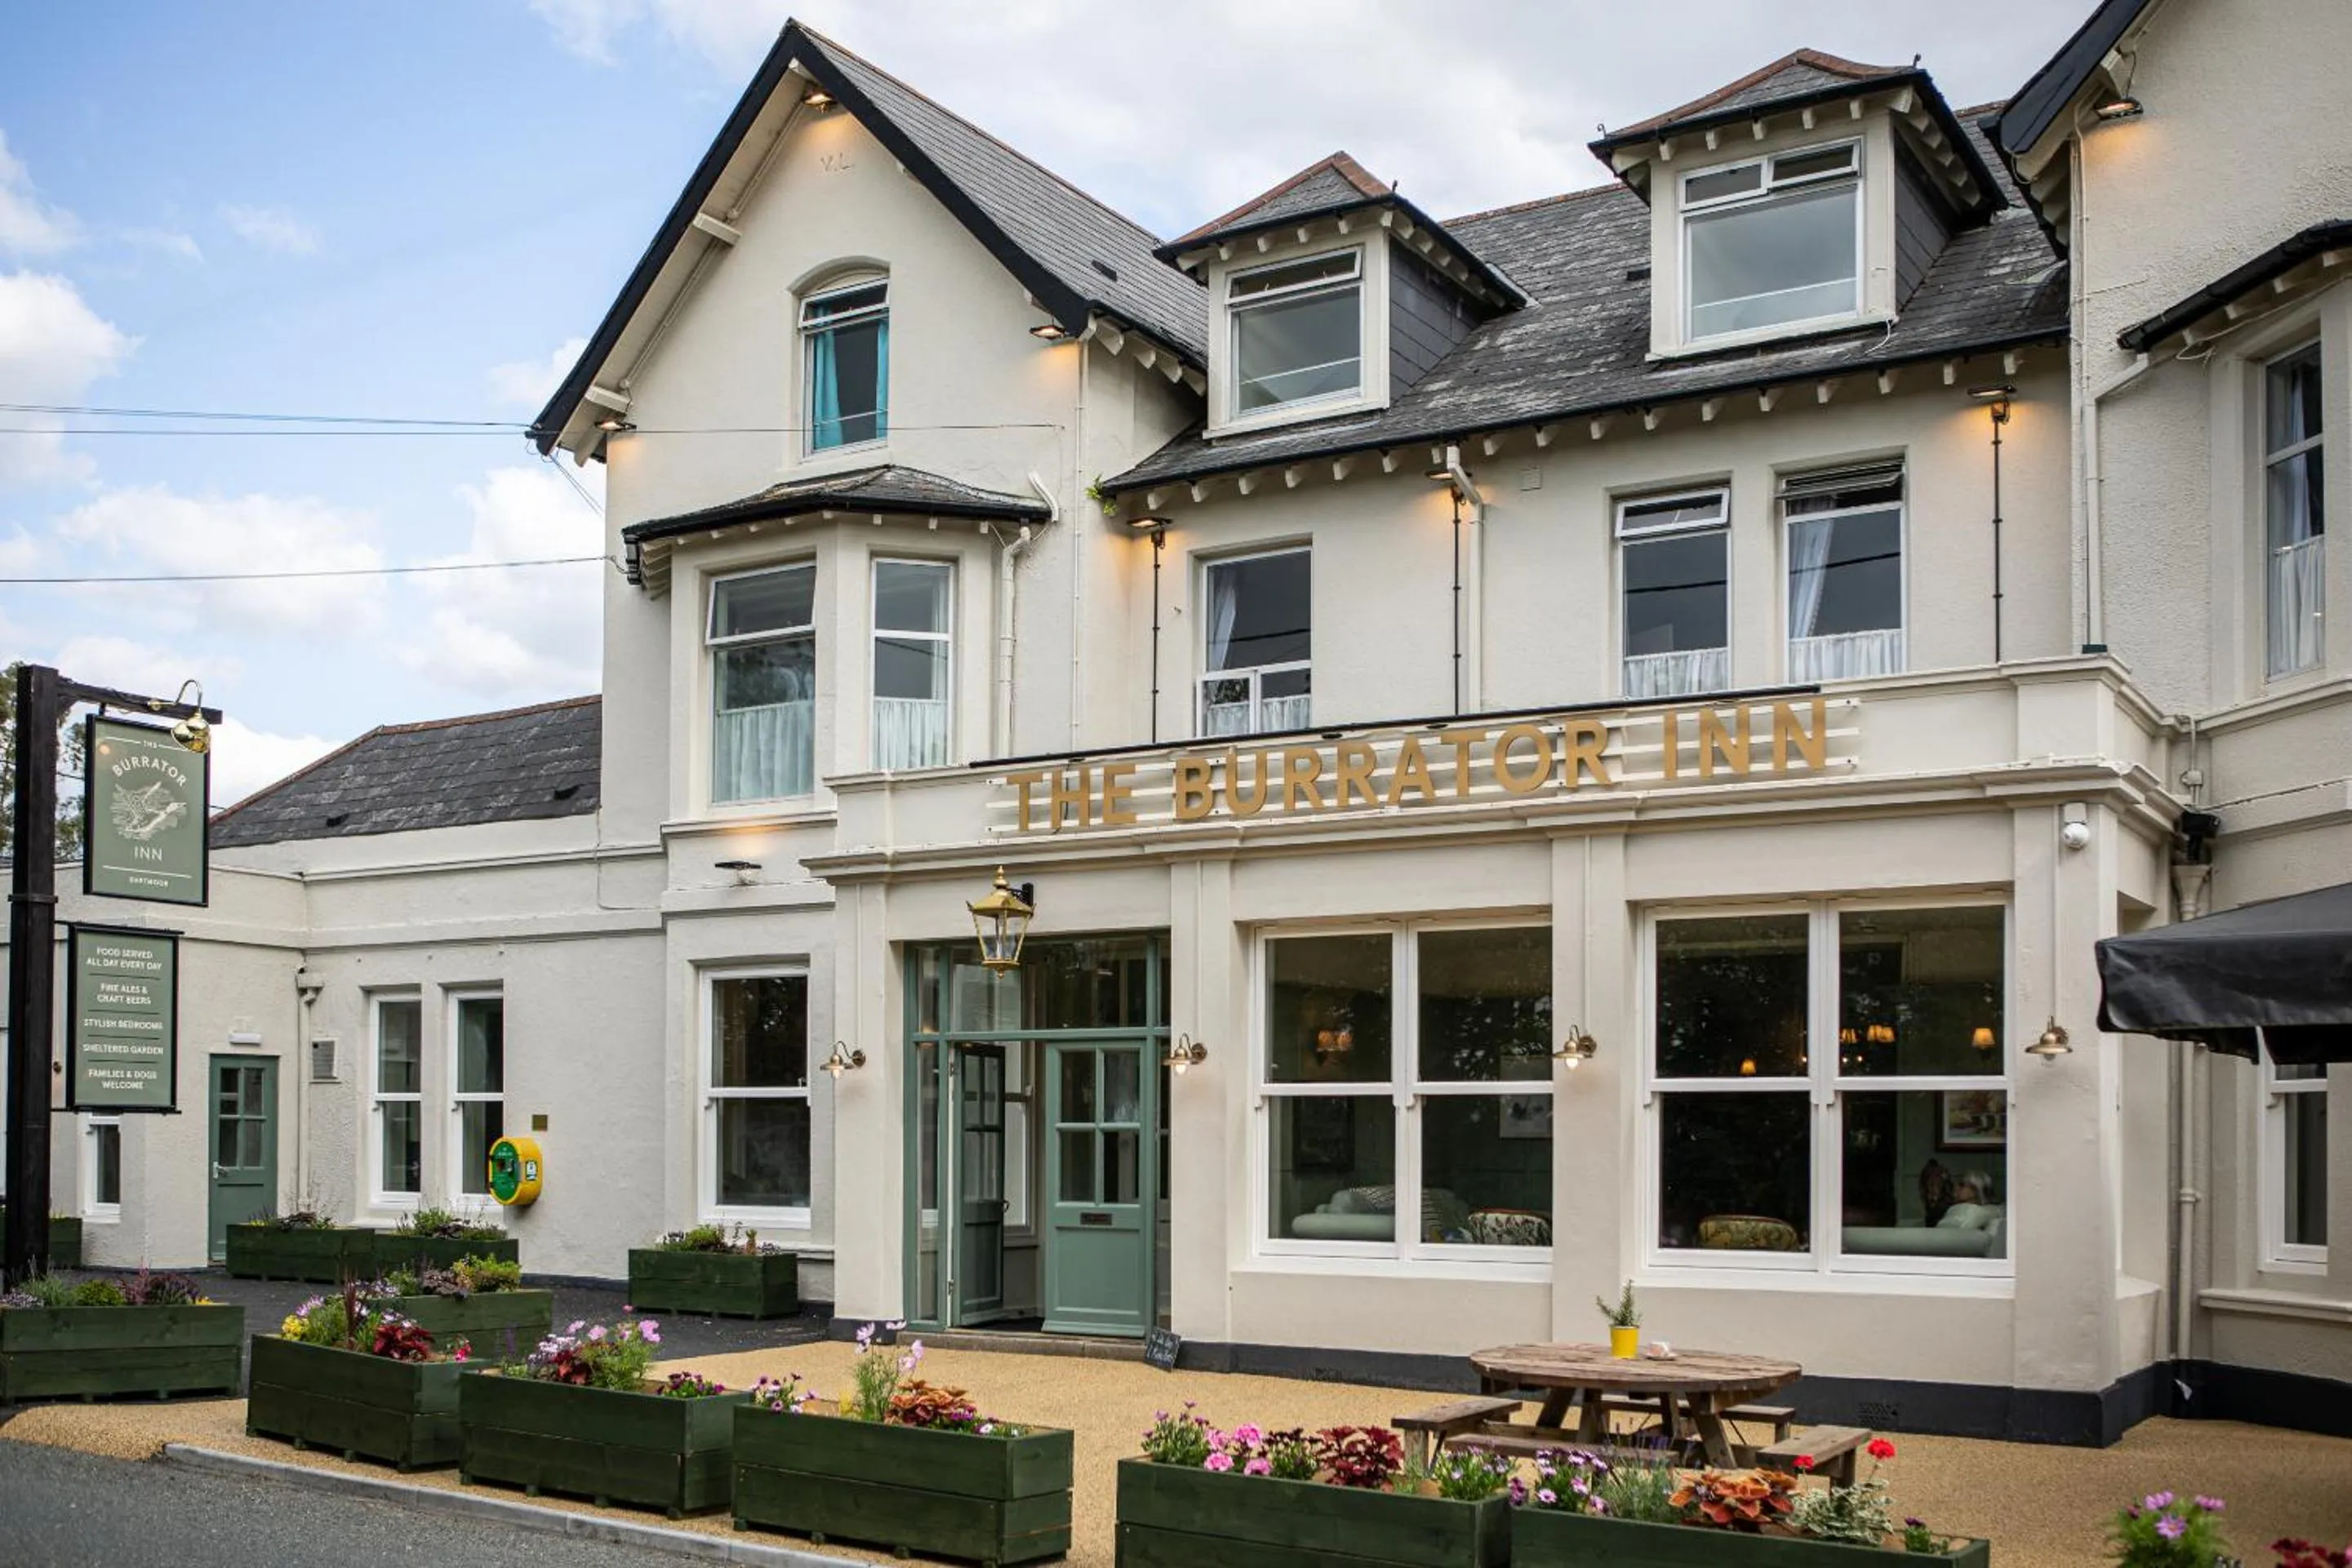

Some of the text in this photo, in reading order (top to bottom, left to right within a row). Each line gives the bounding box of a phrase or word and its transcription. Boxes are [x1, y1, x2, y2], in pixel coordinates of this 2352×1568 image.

[1007, 698, 1826, 832] THE BURRATOR INN
[112, 756, 188, 788] BURRATOR
[134, 846, 163, 861] INN
[96, 947, 153, 959] FOOD SERVED
[86, 957, 162, 970] ALL DAY EVERY DAY
[100, 983, 148, 993] FINE ALES &
[97, 994, 151, 1005] CRAFT BEERS
[83, 1019, 163, 1029] STYLISH BEDROOMS
[82, 1044, 163, 1055] SHELTERED GARDEN
[88, 1068, 157, 1080] FAMILIES & DOGS
[102, 1080, 144, 1090] WELCOME
